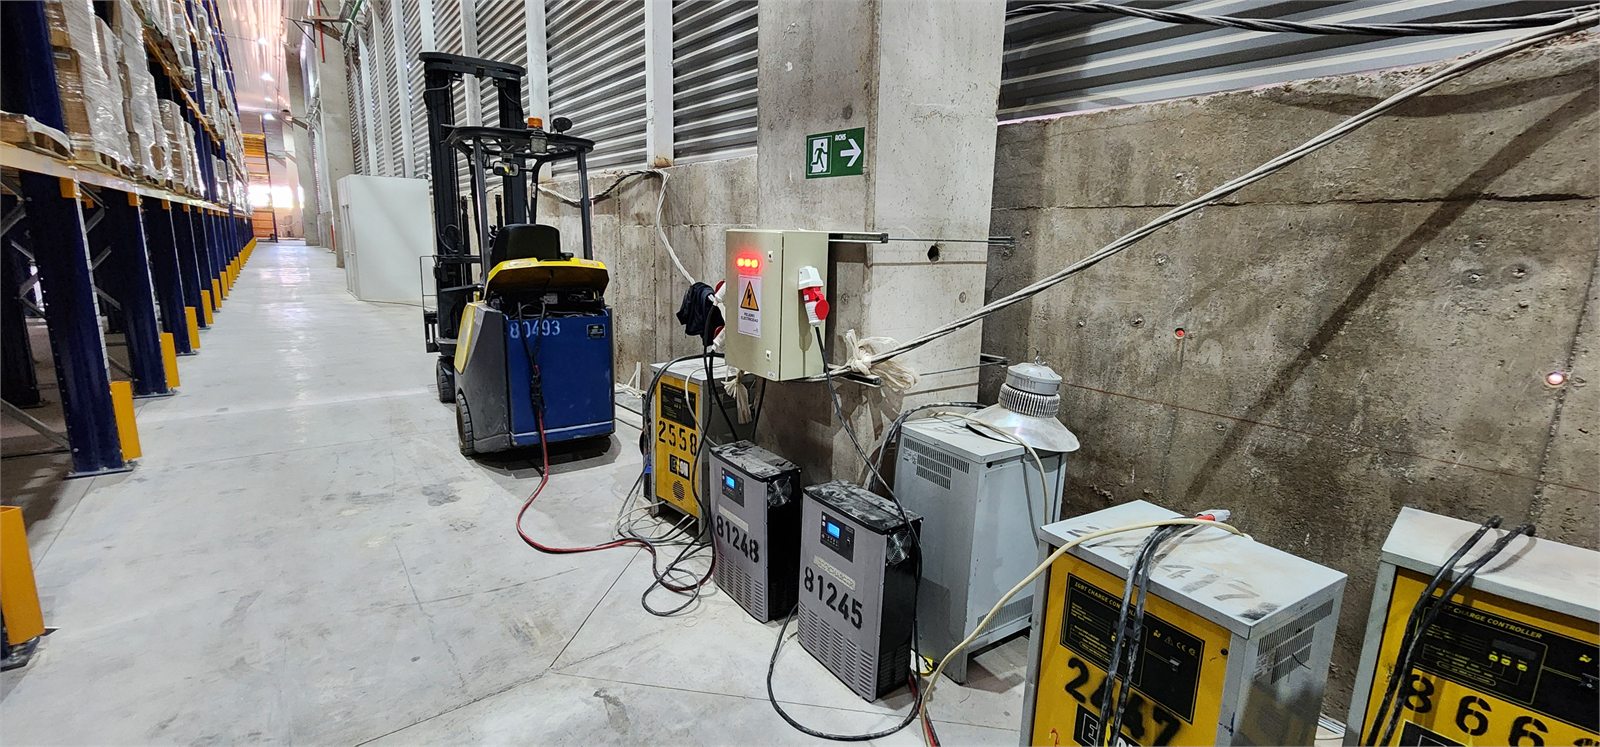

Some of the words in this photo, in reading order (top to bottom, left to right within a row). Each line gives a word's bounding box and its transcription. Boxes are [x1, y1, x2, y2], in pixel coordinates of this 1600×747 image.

[509, 319, 560, 339] 80493
[658, 420, 697, 457] 2558
[716, 514, 760, 563] 81248
[804, 566, 863, 630] 81245
[1087, 588, 1108, 603] CHARGE
[1453, 607, 1486, 622] CHARGE
[1486, 617, 1543, 639] CONTROLLER
[1403, 673, 1600, 747] 866
